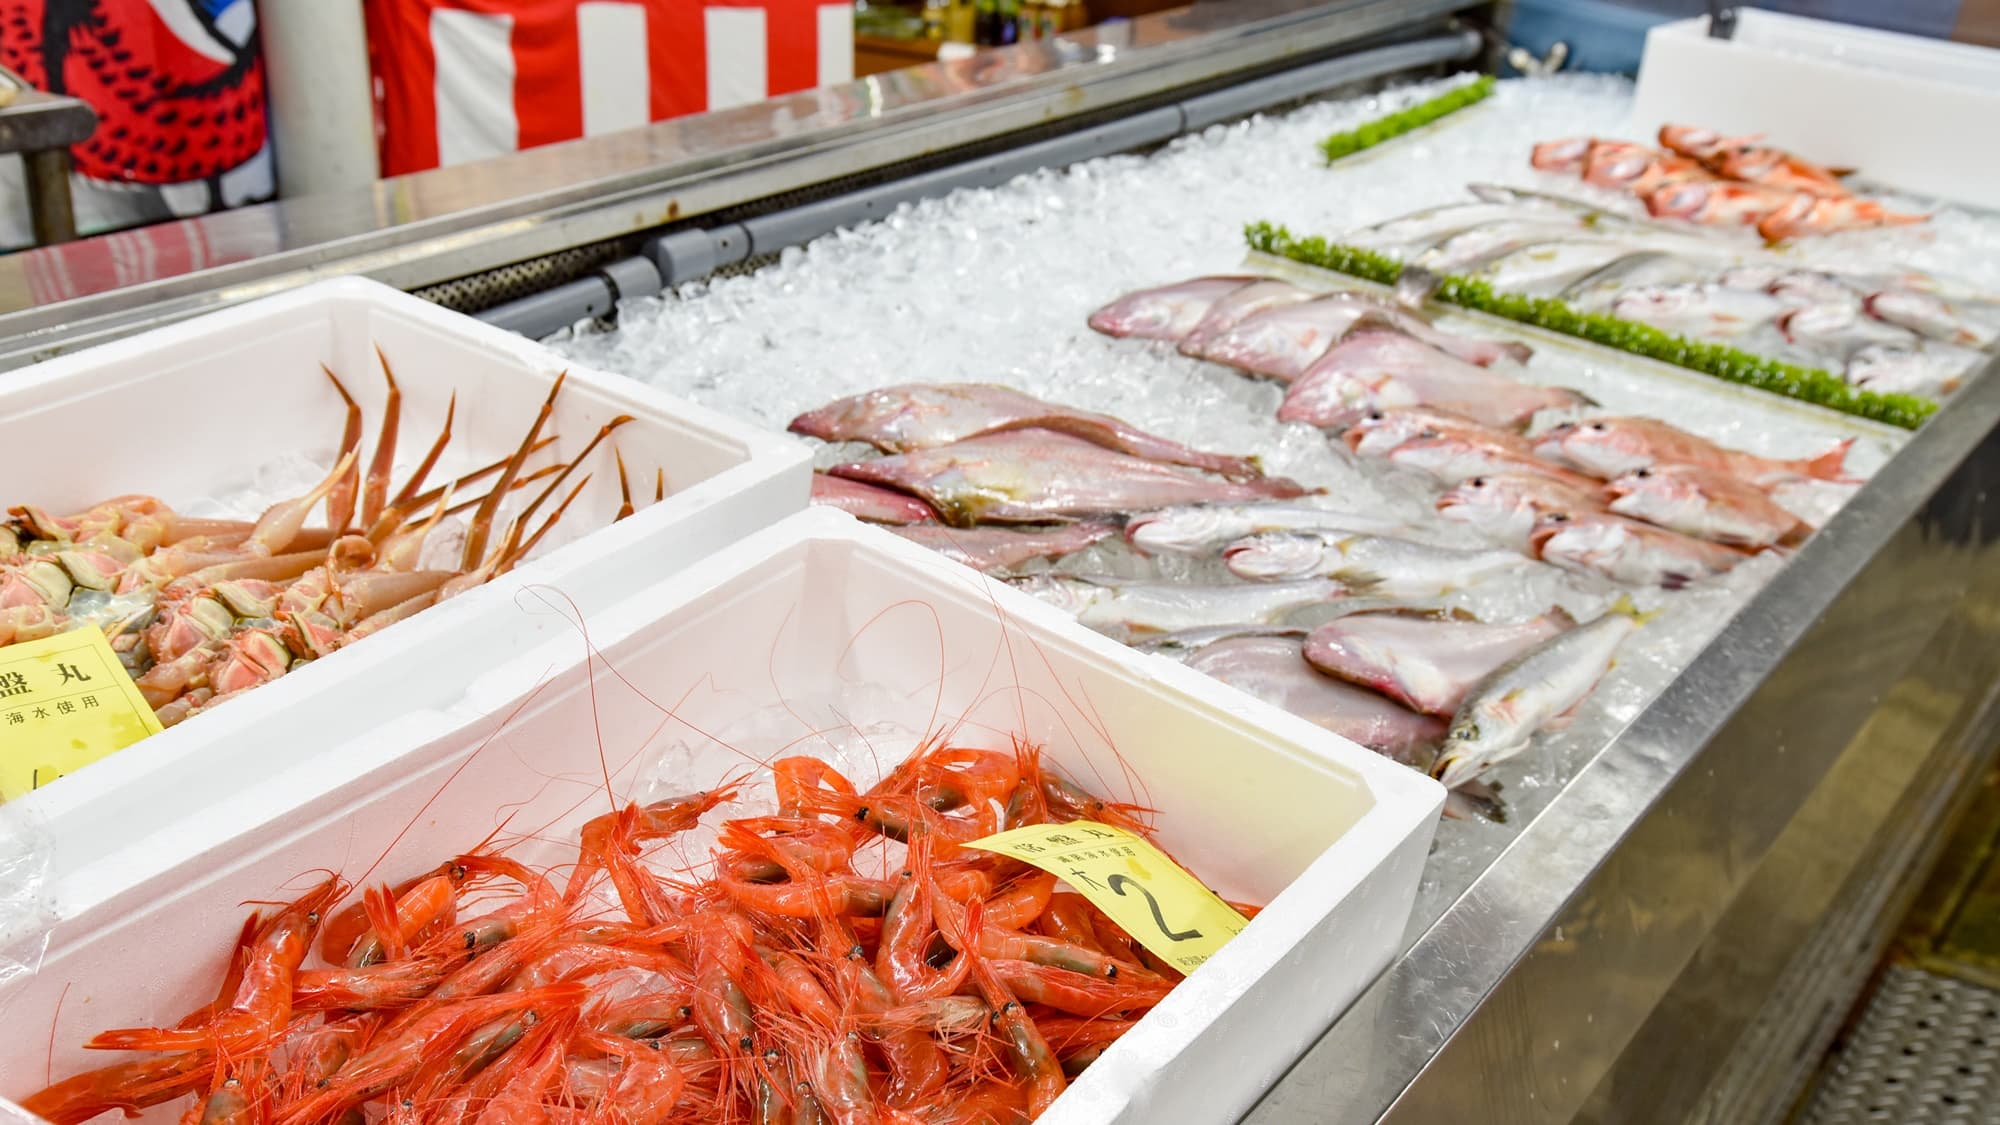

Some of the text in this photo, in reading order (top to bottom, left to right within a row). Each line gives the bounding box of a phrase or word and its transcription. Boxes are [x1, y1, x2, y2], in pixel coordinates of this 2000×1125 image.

[6, 695, 99, 725] 海水使用
[1108, 874, 1203, 941] 2
